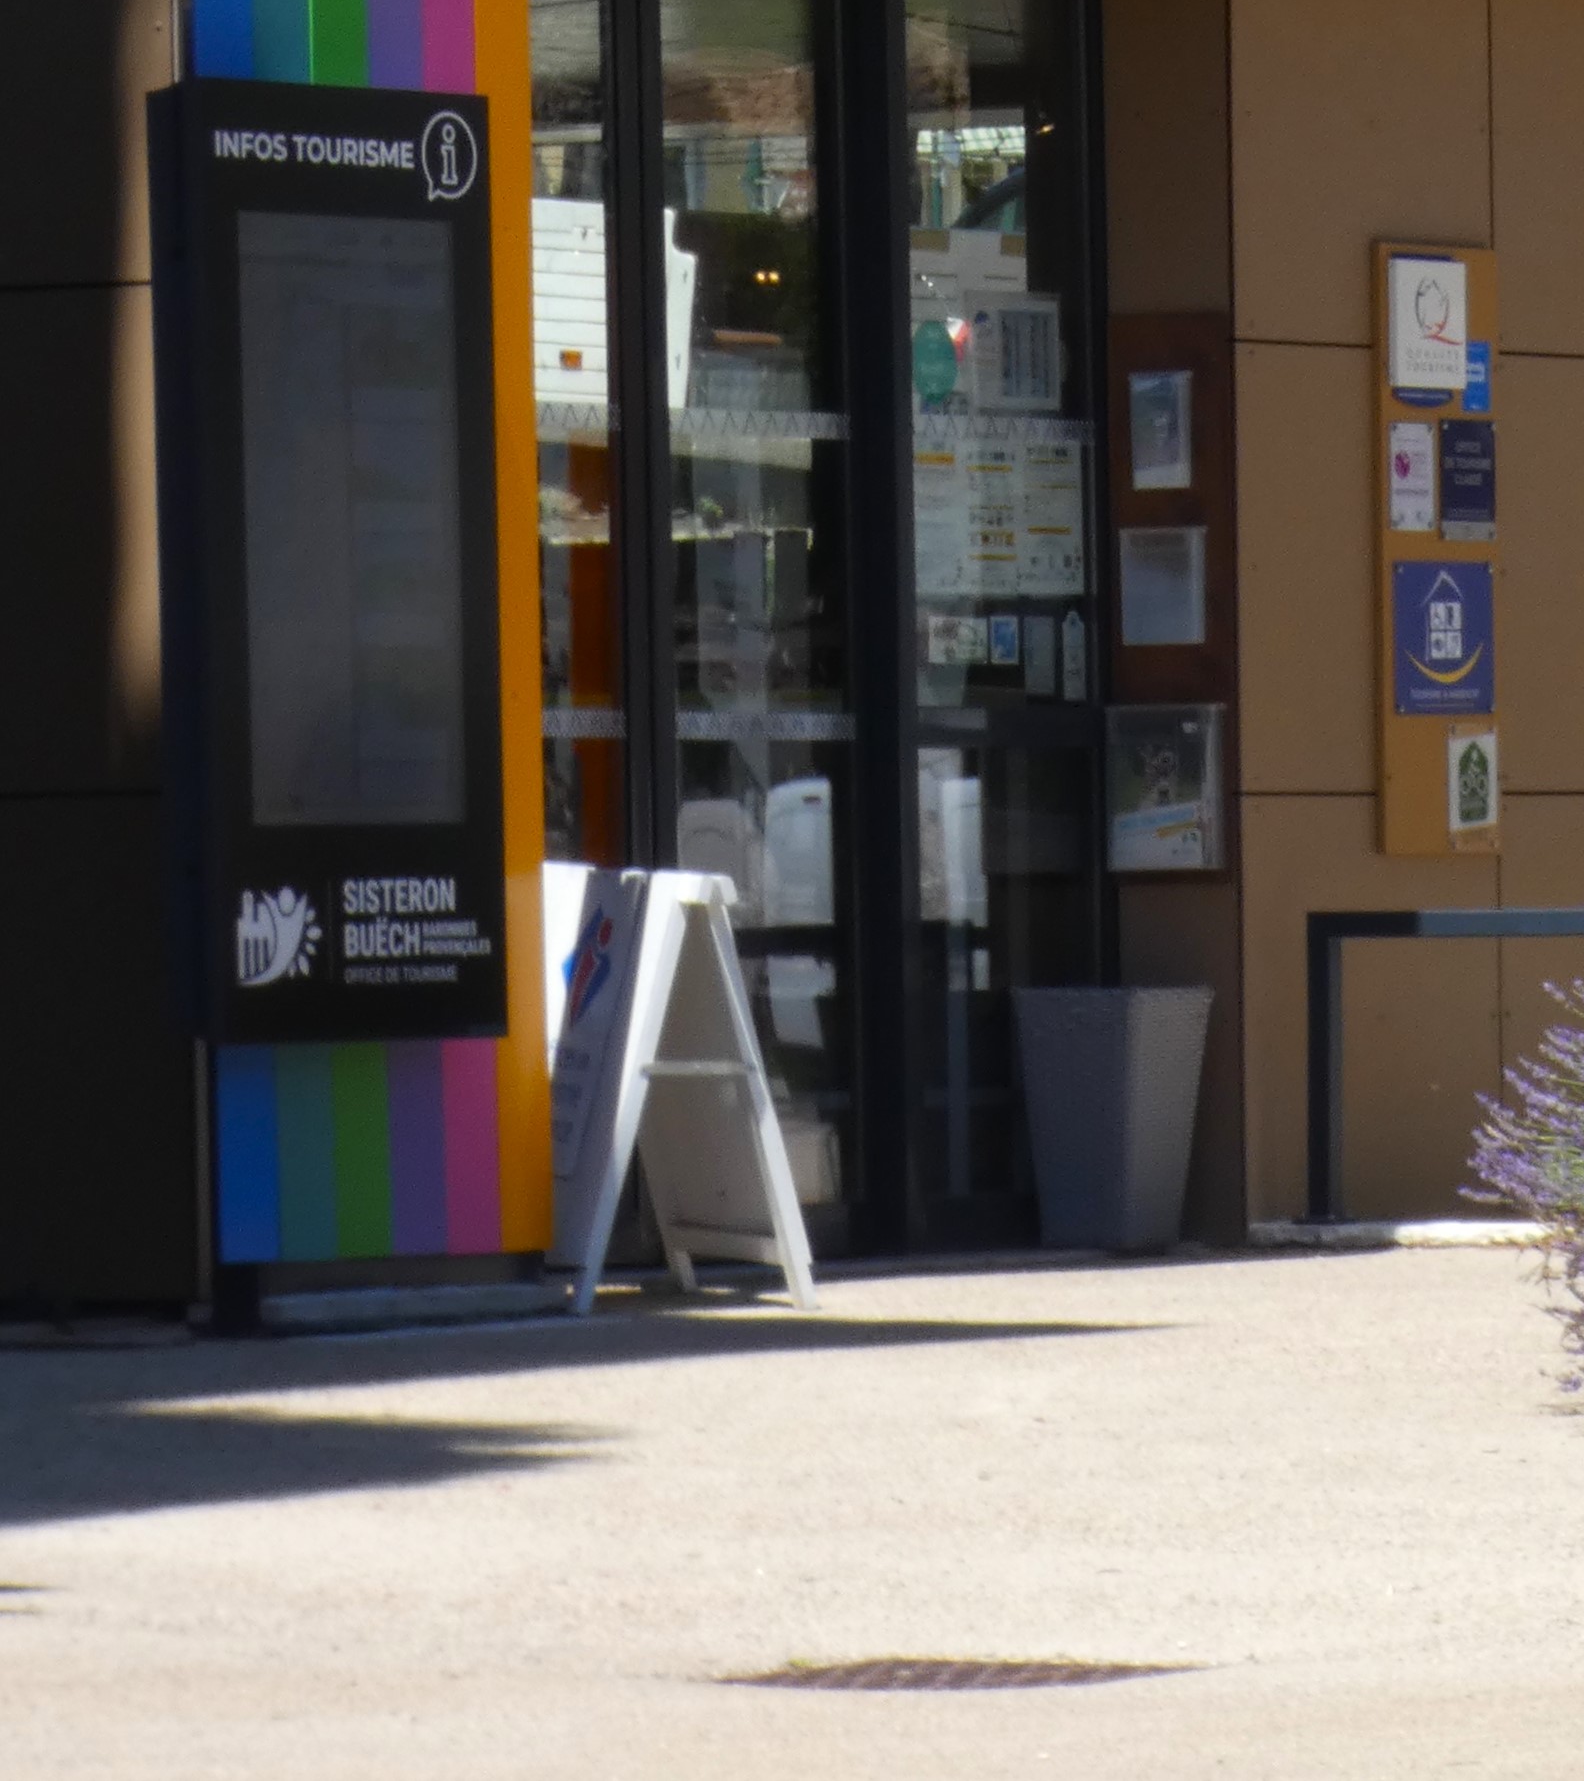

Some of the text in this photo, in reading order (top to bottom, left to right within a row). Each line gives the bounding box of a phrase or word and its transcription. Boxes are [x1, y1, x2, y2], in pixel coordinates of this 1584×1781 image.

[214, 129, 415, 169] INFOS TOURISME
[343, 876, 456, 914] SISTERON
[344, 917, 420, 958] BUËCH
